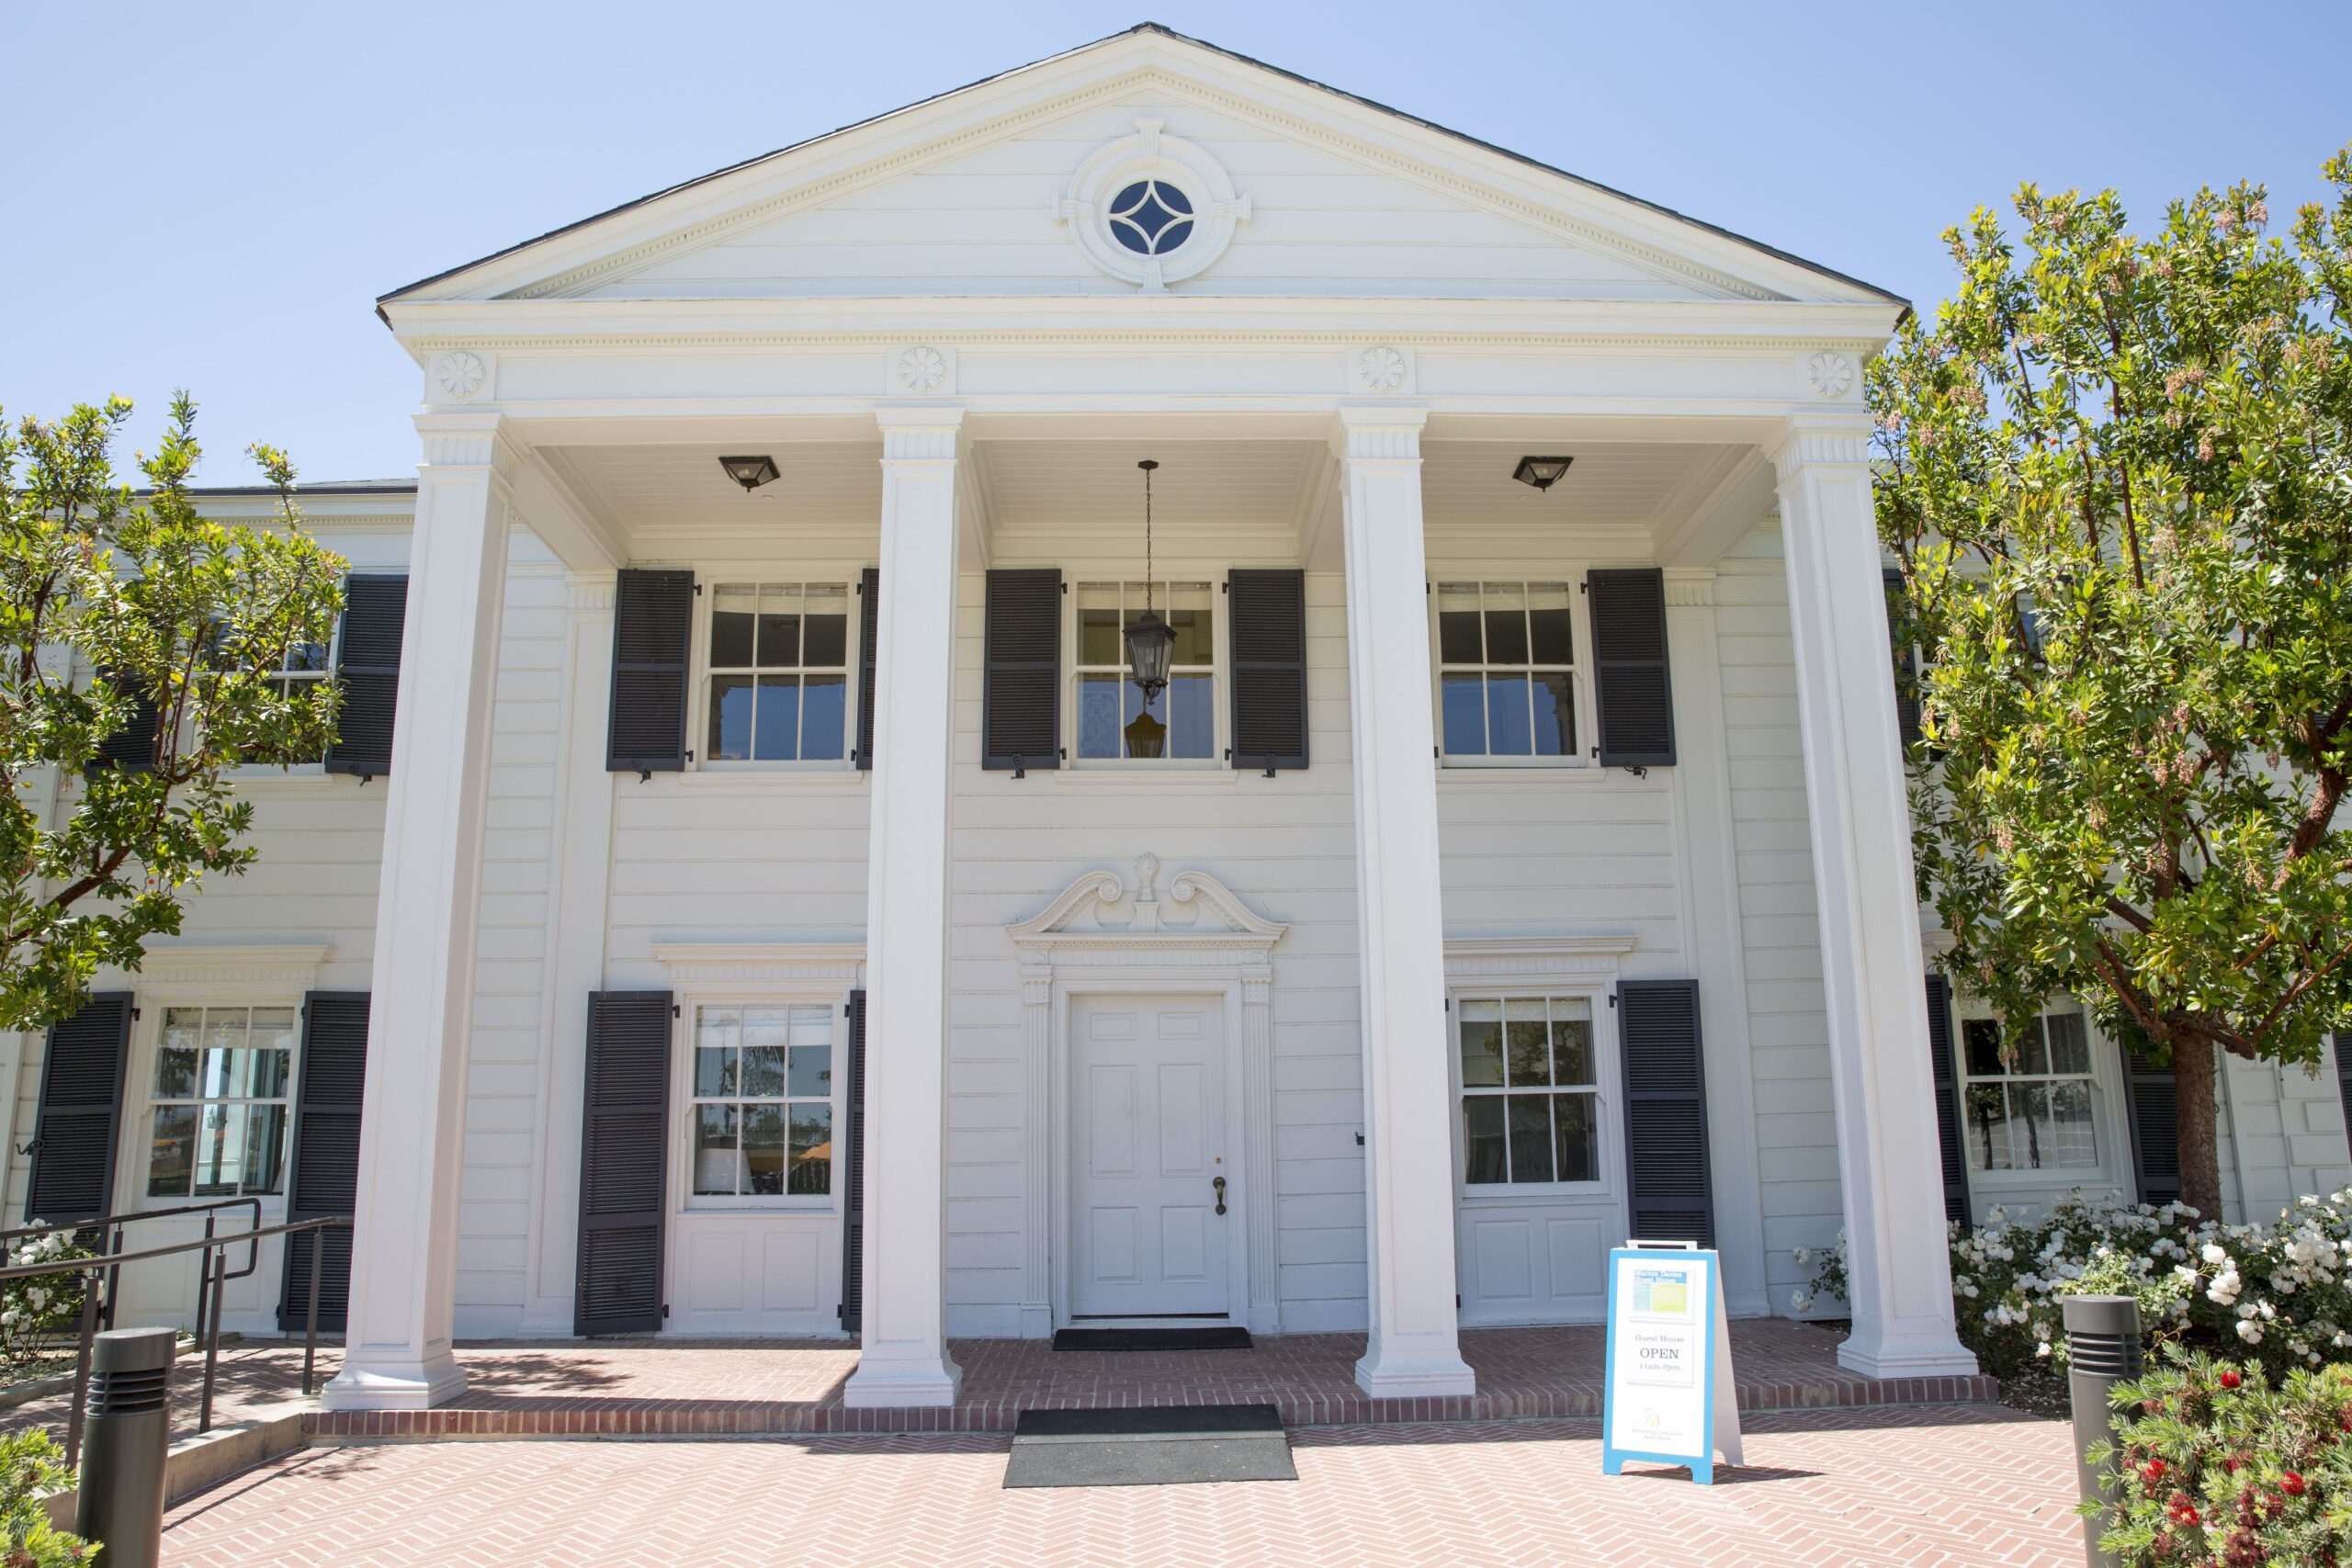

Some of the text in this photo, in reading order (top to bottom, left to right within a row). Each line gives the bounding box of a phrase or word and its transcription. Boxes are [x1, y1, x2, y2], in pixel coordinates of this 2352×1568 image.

[1634, 1334, 1685, 1343] Guest House
[1640, 1348, 1679, 1359] OPEN
